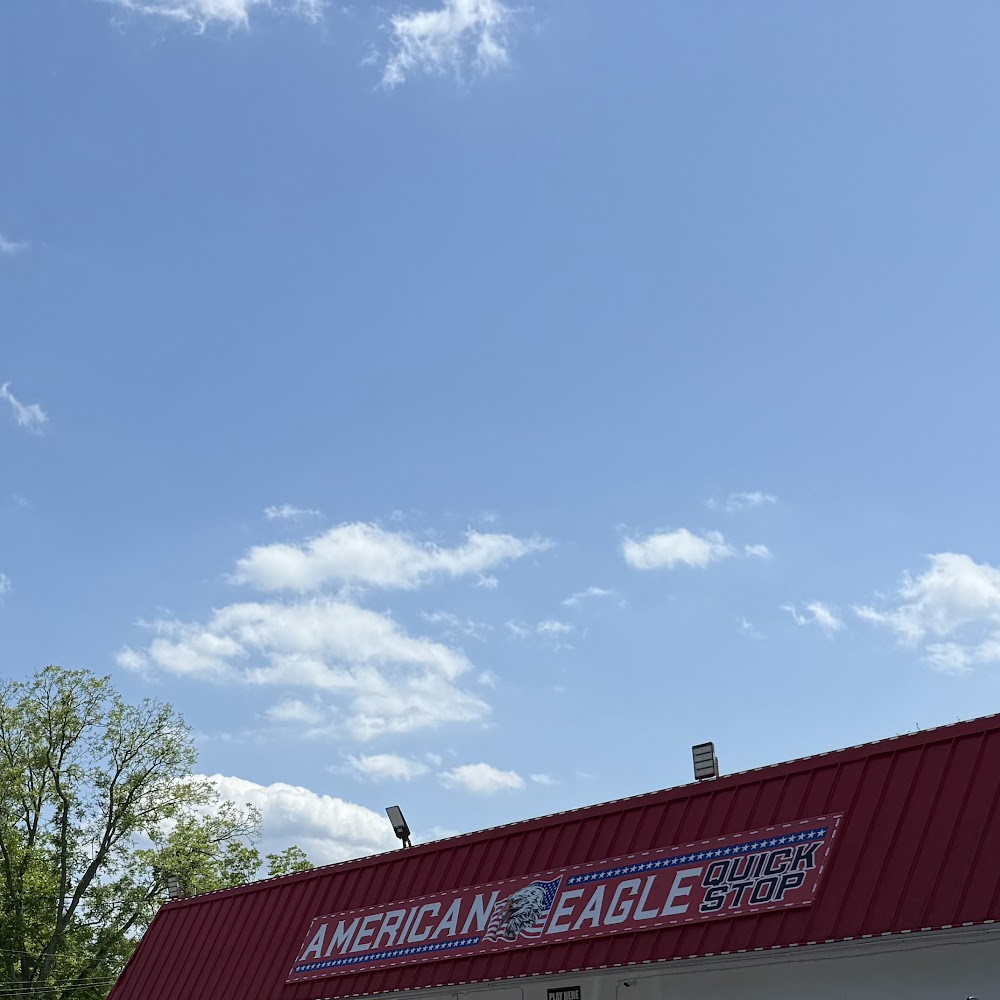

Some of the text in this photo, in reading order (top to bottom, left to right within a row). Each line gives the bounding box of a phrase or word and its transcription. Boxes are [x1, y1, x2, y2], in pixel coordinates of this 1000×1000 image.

[702, 841, 825, 888] QUICK
[300, 867, 703, 962] AMERICAN EAGLE
[699, 871, 805, 914] STOP
[563, 990, 580, 1000] HERE
